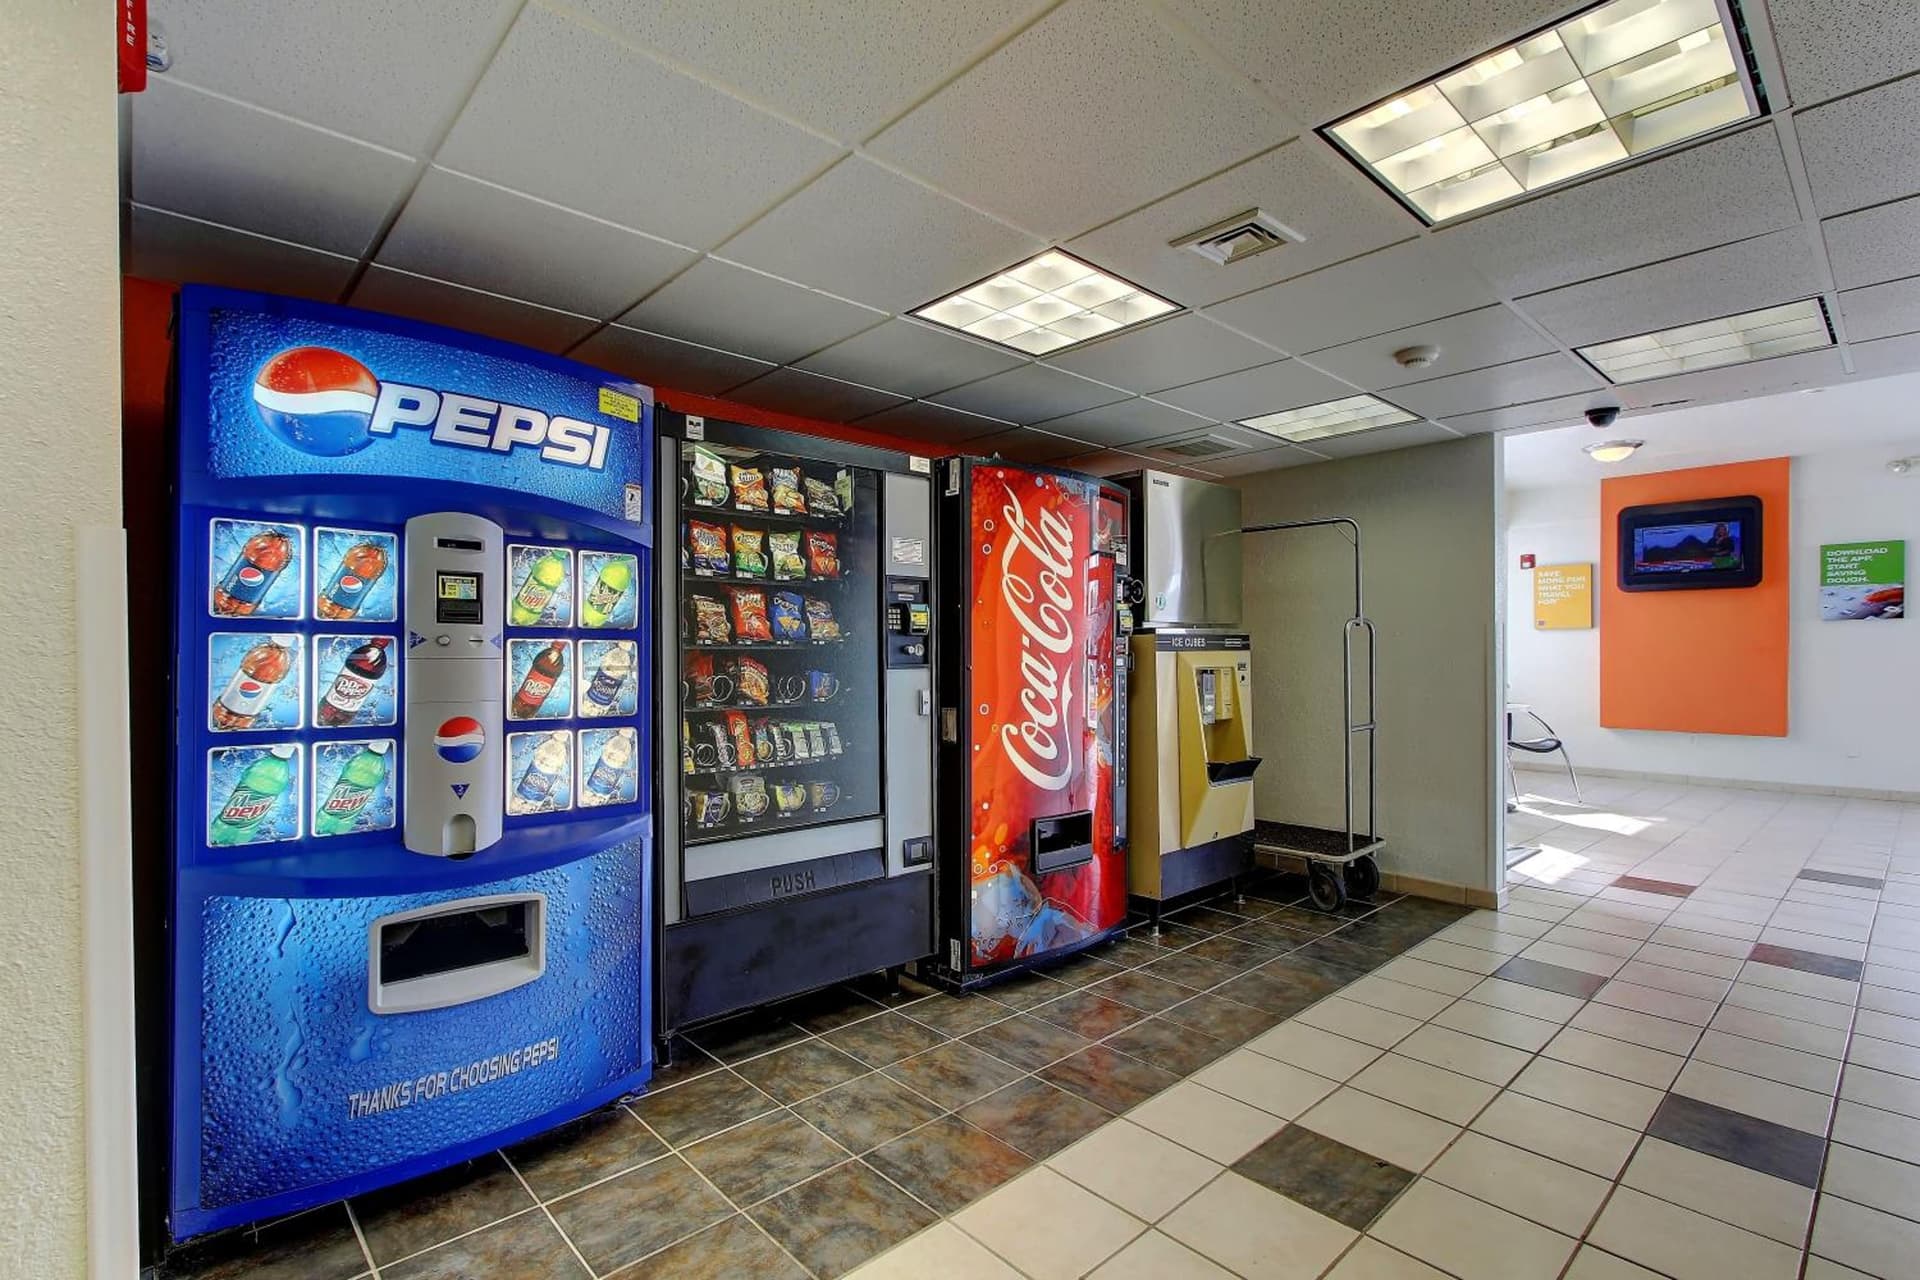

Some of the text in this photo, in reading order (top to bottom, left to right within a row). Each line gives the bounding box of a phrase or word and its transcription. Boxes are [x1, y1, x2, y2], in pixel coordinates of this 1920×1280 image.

[369, 381, 611, 470] PEPSI
[1826, 547, 1888, 557] DOWNLOAD
[1002, 481, 1074, 791] Coca-Cola
[1172, 637, 1206, 647] ICE CUBES
[770, 869, 816, 897] PUSH
[348, 1037, 560, 1120] THANKS FOR CHOOSING PEPSI
